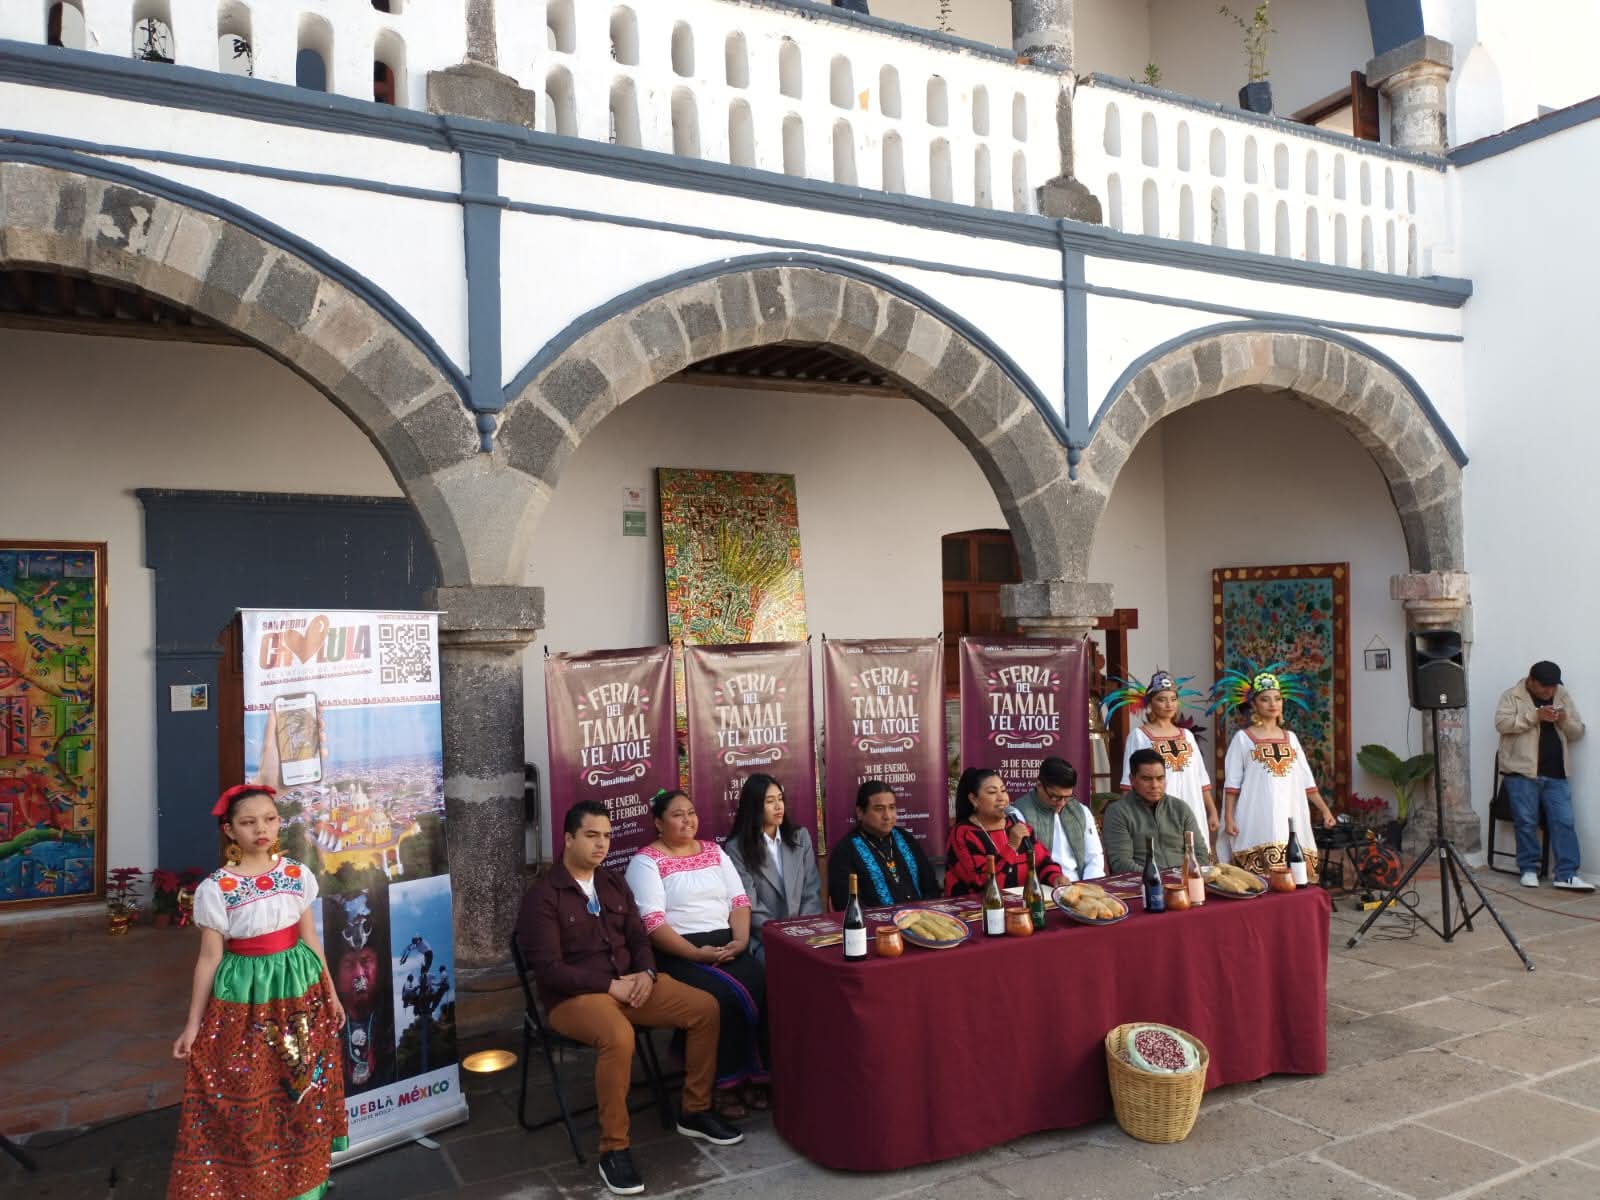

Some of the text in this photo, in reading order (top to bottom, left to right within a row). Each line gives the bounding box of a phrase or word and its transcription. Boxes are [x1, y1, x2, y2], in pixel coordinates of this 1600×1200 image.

[262, 620, 279, 630] SAN
[726, 673, 776, 697] FERIA
[860, 666, 909, 688] FERIA
[998, 665, 1051, 687] FERIA
[587, 682, 640, 711] FERIA
[877, 685, 892, 696] DEL
[1016, 683, 1031, 693] DEL
[743, 693, 759, 704] DEL
[851, 695, 919, 719] TAMAL
[988, 693, 1060, 716] TAMAL
[607, 703, 622, 717] DEL
[715, 702, 787, 730] TAMAL
[579, 713, 651, 749] TAMAL
[853, 717, 920, 736] Y EL ATOLE
[989, 715, 1060, 731] Y EL ATOLE
[718, 727, 788, 748] Y EL ATOLE
[581, 740, 651, 767] Y EL ATOLE
[864, 764, 871, 774] 31
[873, 763, 883, 773] DE
[1000, 759, 1008, 768] 31
[1010, 759, 1020, 768] DE
[1010, 769, 1020, 778] DE
[617, 804, 649, 820] FEBRERO
